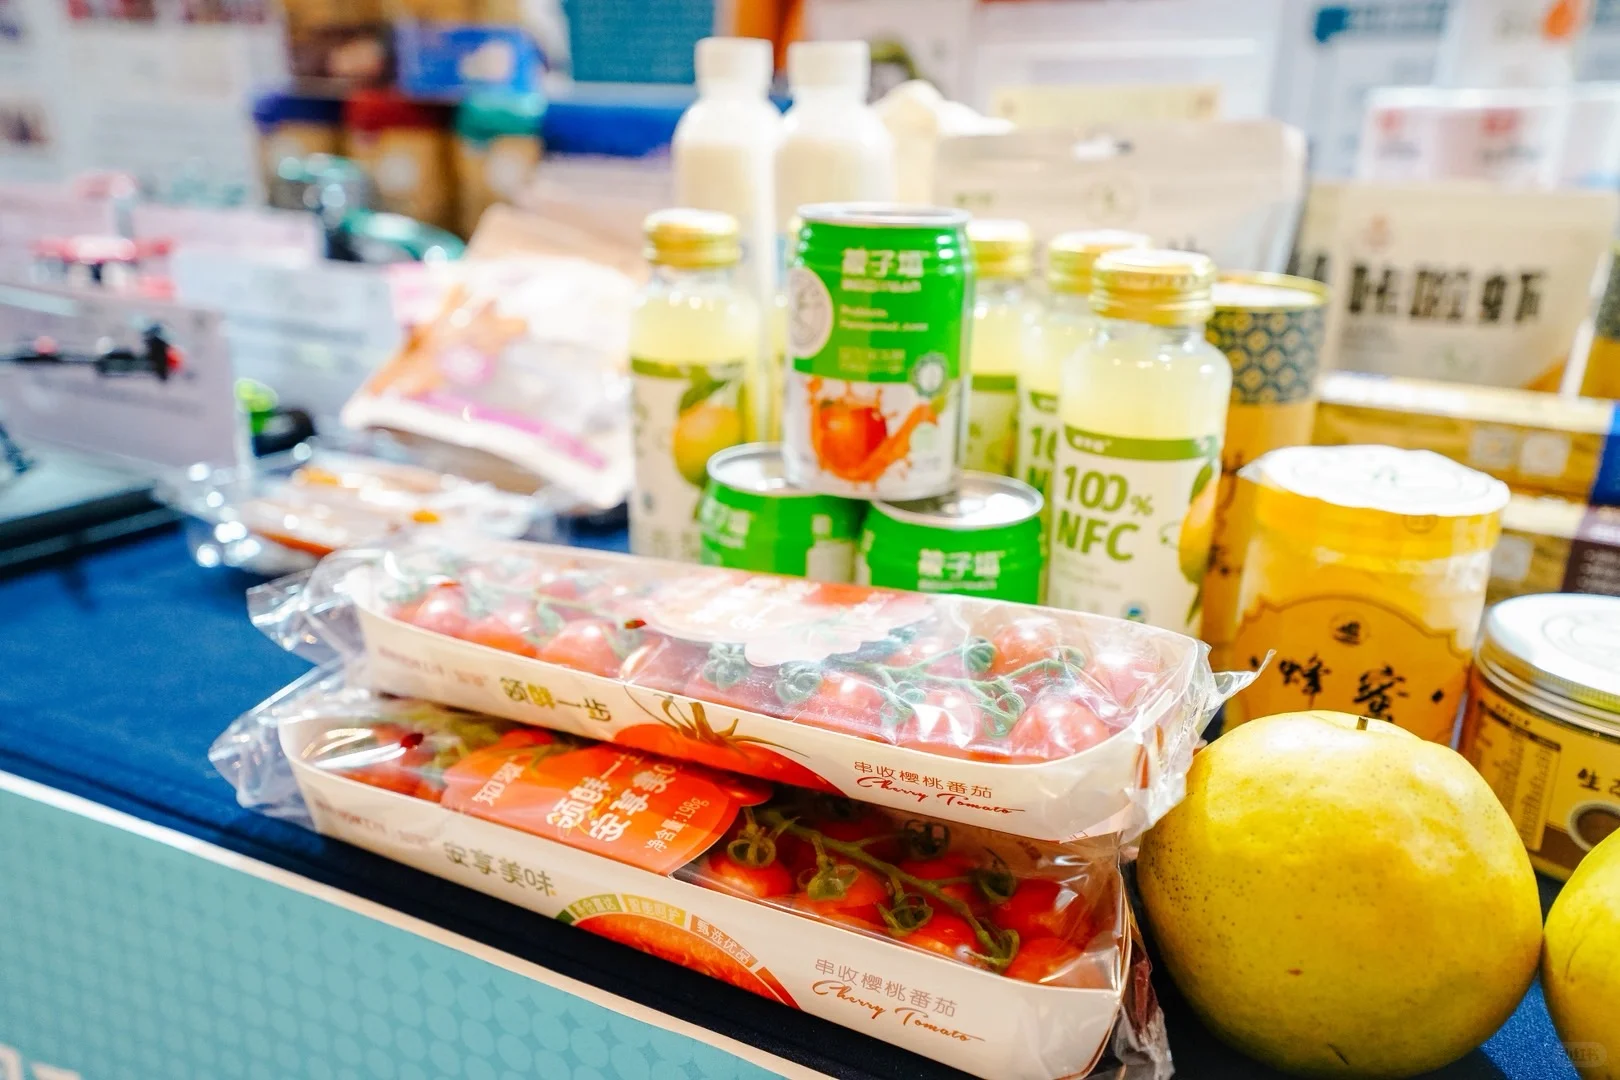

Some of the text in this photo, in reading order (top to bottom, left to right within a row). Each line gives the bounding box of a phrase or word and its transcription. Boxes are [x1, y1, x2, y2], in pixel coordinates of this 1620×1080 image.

[1064, 465, 1154, 516] 100%
[1056, 510, 1140, 563] NFC
[499, 676, 612, 722] 领鲜一步
[1278, 652, 1411, 723] 蜂蜜
[854, 761, 992, 799] 串收樱桃番茄
[856, 776, 1026, 815] Cherry Tomato
[645, 797, 710, 852] 净含量:198g
[442, 841, 557, 897] 安享美味
[697, 919, 751, 965] 甄选优品
[812, 980, 986, 1042] Cherry Tomato
[815, 958, 958, 1018] 串收樱桃番茄
